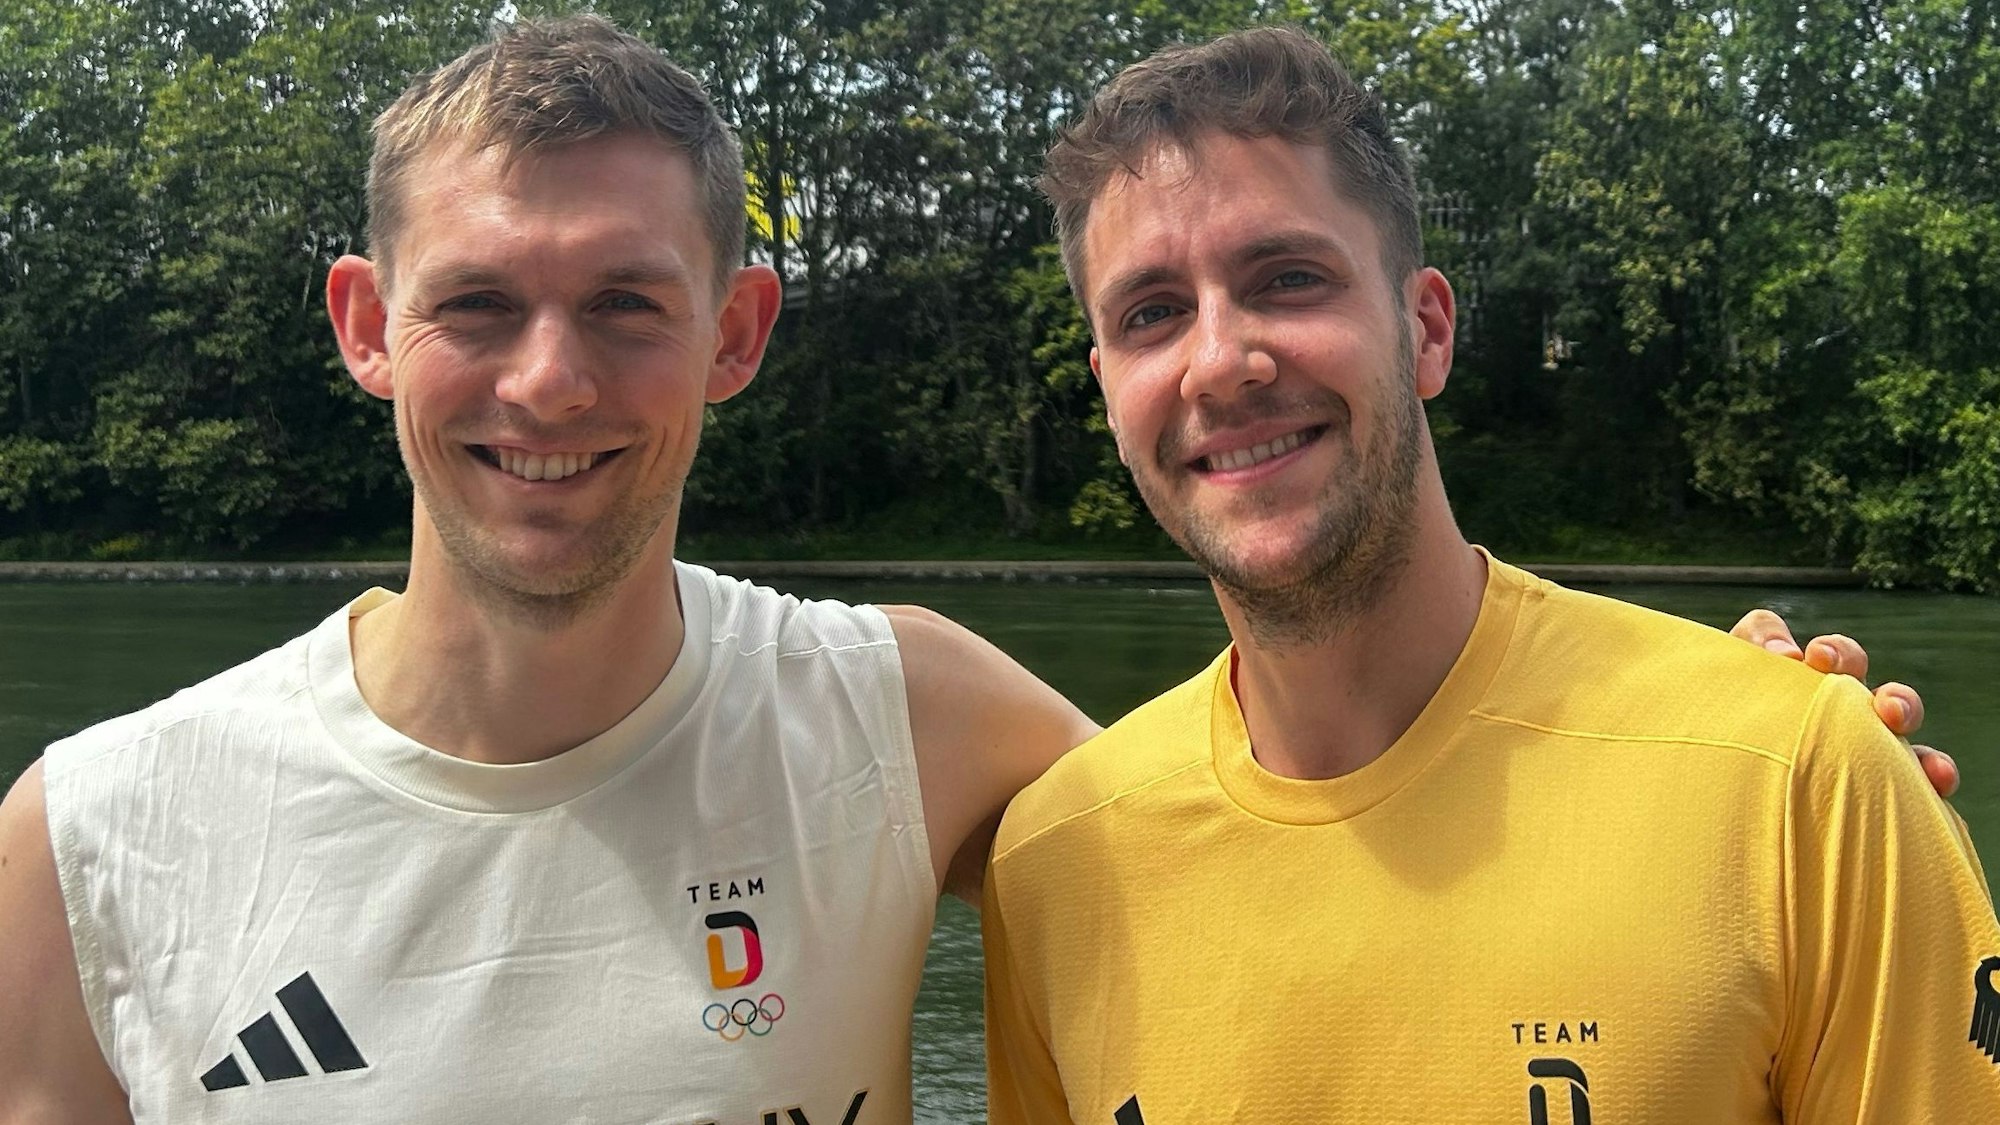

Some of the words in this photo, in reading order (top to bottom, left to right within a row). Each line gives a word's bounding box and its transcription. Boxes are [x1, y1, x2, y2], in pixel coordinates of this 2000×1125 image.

[687, 877, 764, 903] TEAM
[705, 911, 763, 990] D
[1511, 1021, 1599, 1044] TEAM
